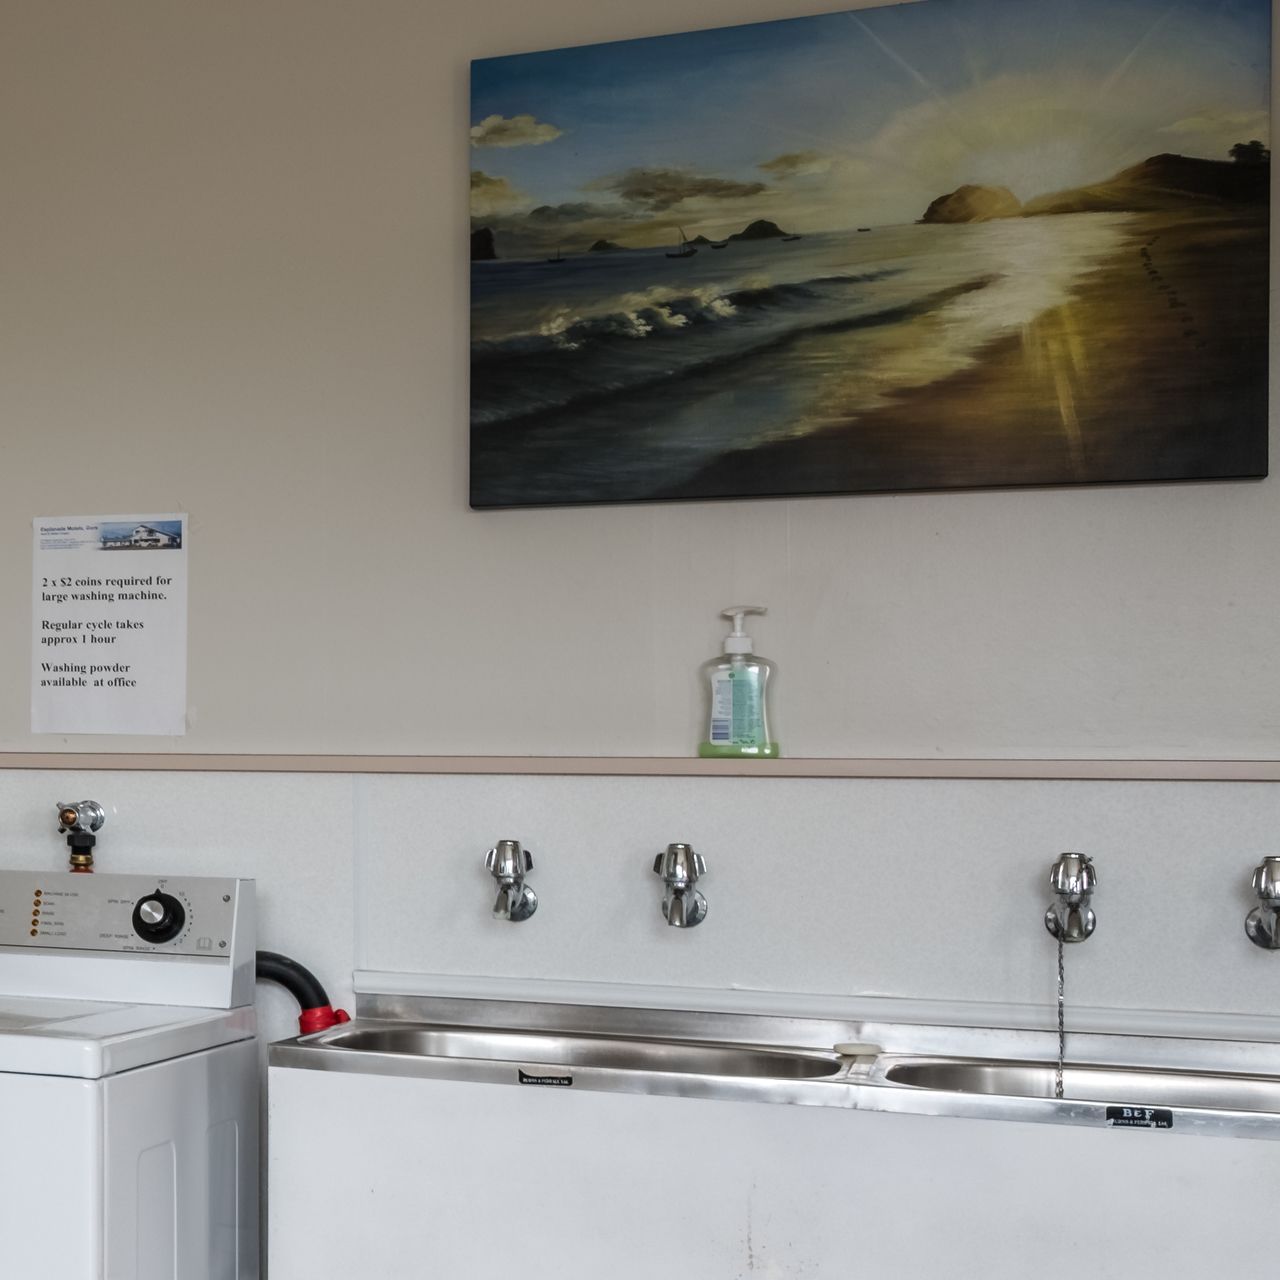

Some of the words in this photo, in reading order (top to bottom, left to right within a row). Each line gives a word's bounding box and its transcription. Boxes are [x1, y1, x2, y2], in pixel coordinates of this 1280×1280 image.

[42, 577, 48, 588] 2
[51, 579, 57, 587] x
[75, 576, 102, 587] coins
[106, 576, 153, 589] required
[156, 576, 172, 586] for
[42, 592, 69, 603] large
[71, 591, 115, 603] washing
[118, 590, 167, 600] machine.
[42, 619, 83, 632] Regular
[86, 620, 112, 632] cycle
[116, 619, 144, 630] takes
[41, 636, 78, 646] approx
[90, 634, 117, 644] hour
[41, 662, 87, 675] Washing
[90, 663, 131, 675] powder
[40, 677, 87, 687] available
[93, 678, 104, 687] at
[107, 677, 137, 687] office
